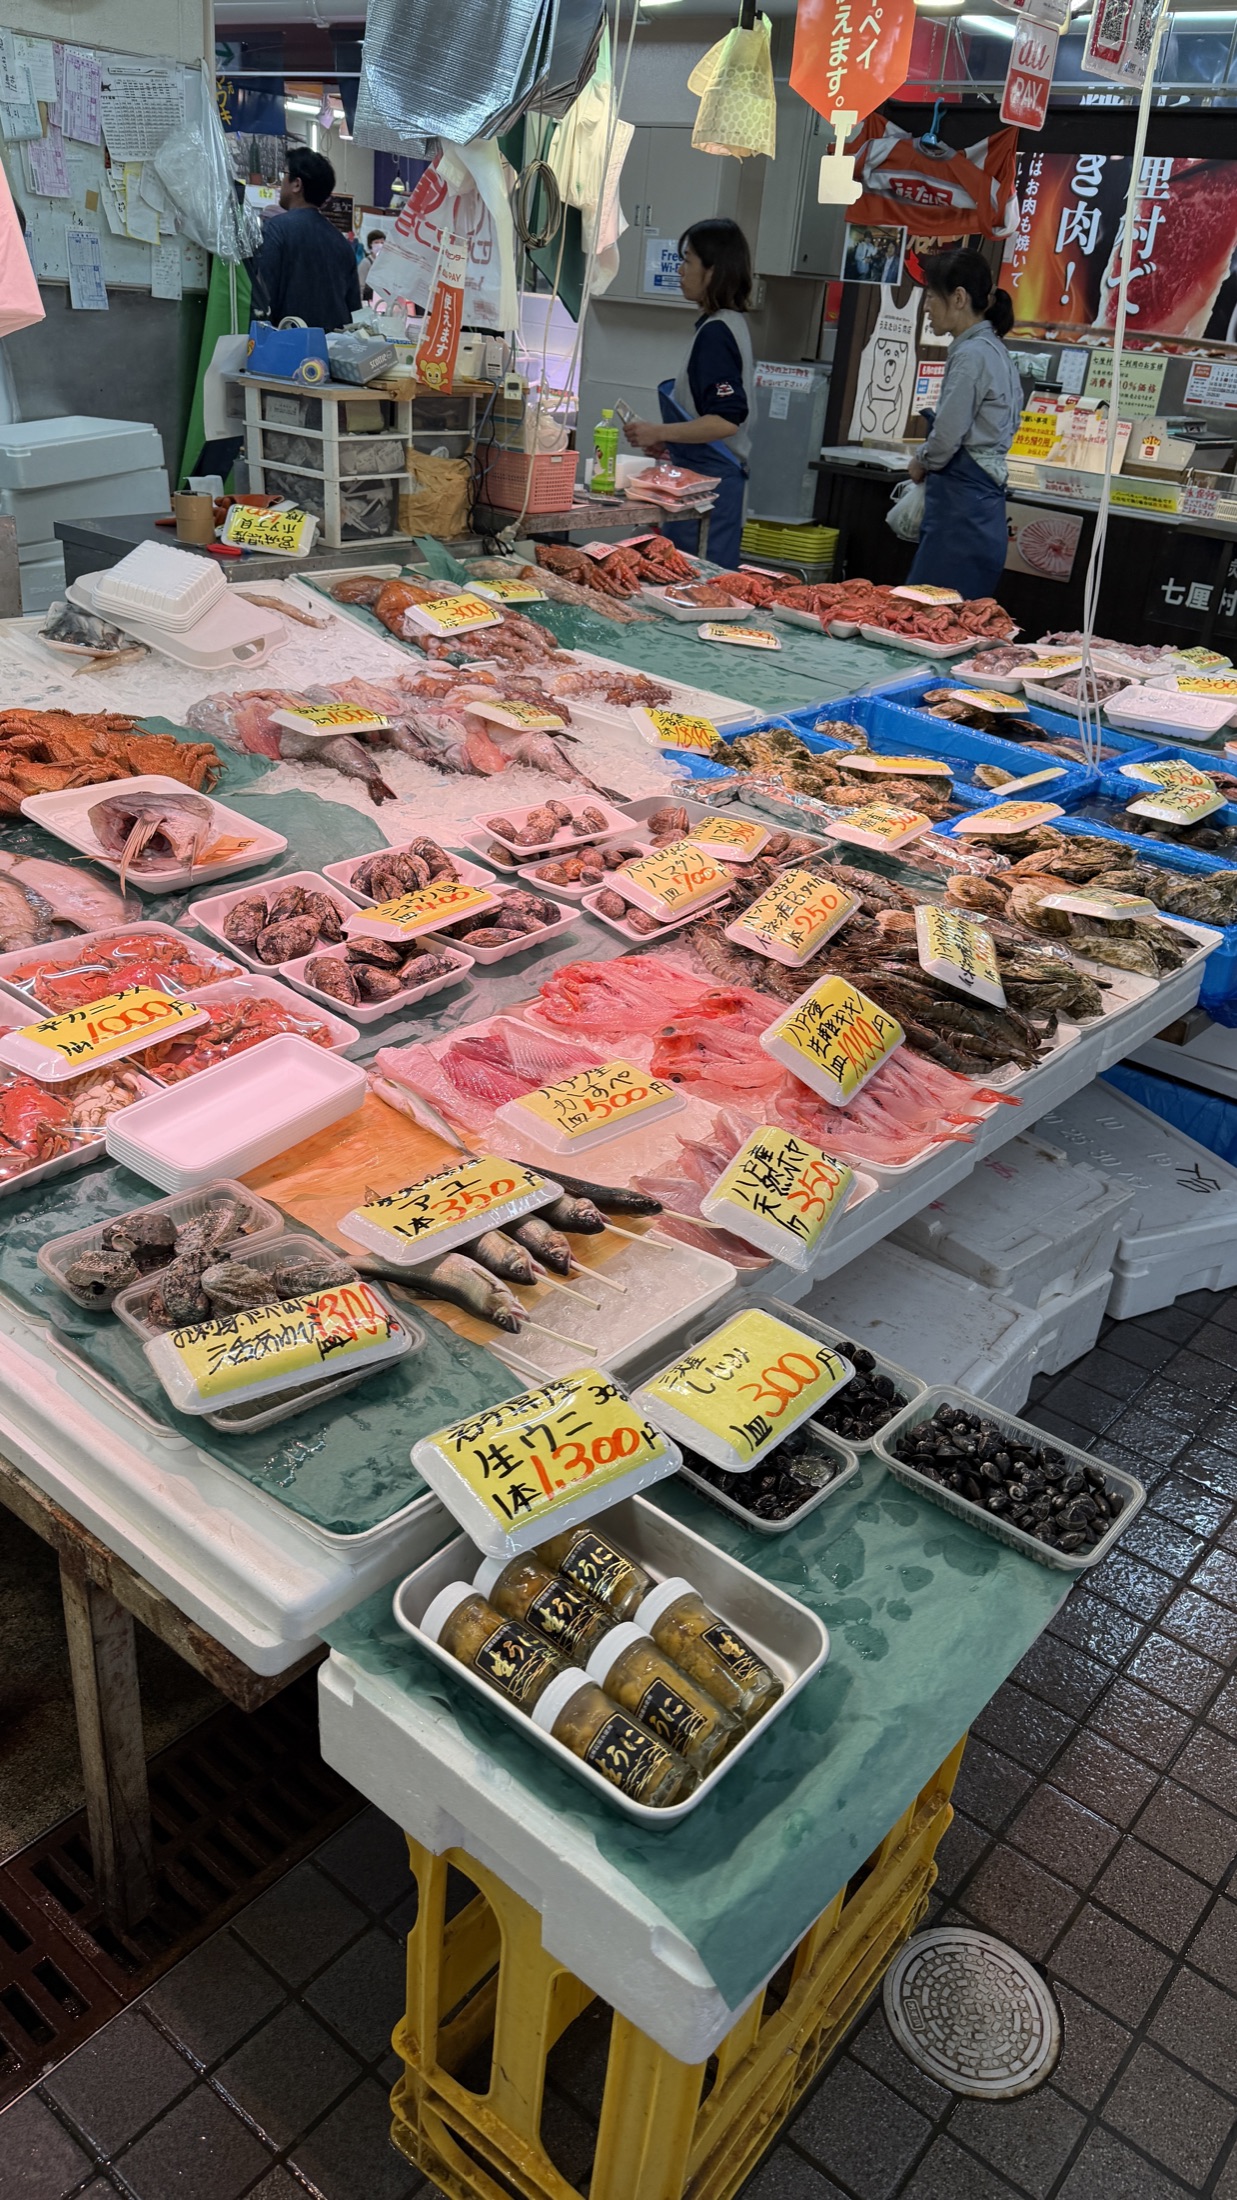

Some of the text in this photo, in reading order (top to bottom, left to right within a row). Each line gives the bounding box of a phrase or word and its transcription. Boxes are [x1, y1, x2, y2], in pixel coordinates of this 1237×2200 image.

[856, 0, 882, 70] ペイ
[826, 0, 856, 108] えます。
[1018, 39, 1050, 71] au
[1015, 76, 1044, 109] PAY
[660, 262, 681, 274] Wi-F
[647, 850, 706, 888] ハマグリ
[397, 1178, 482, 1212] アユ
[473, 1410, 594, 1479] 生ウニ
